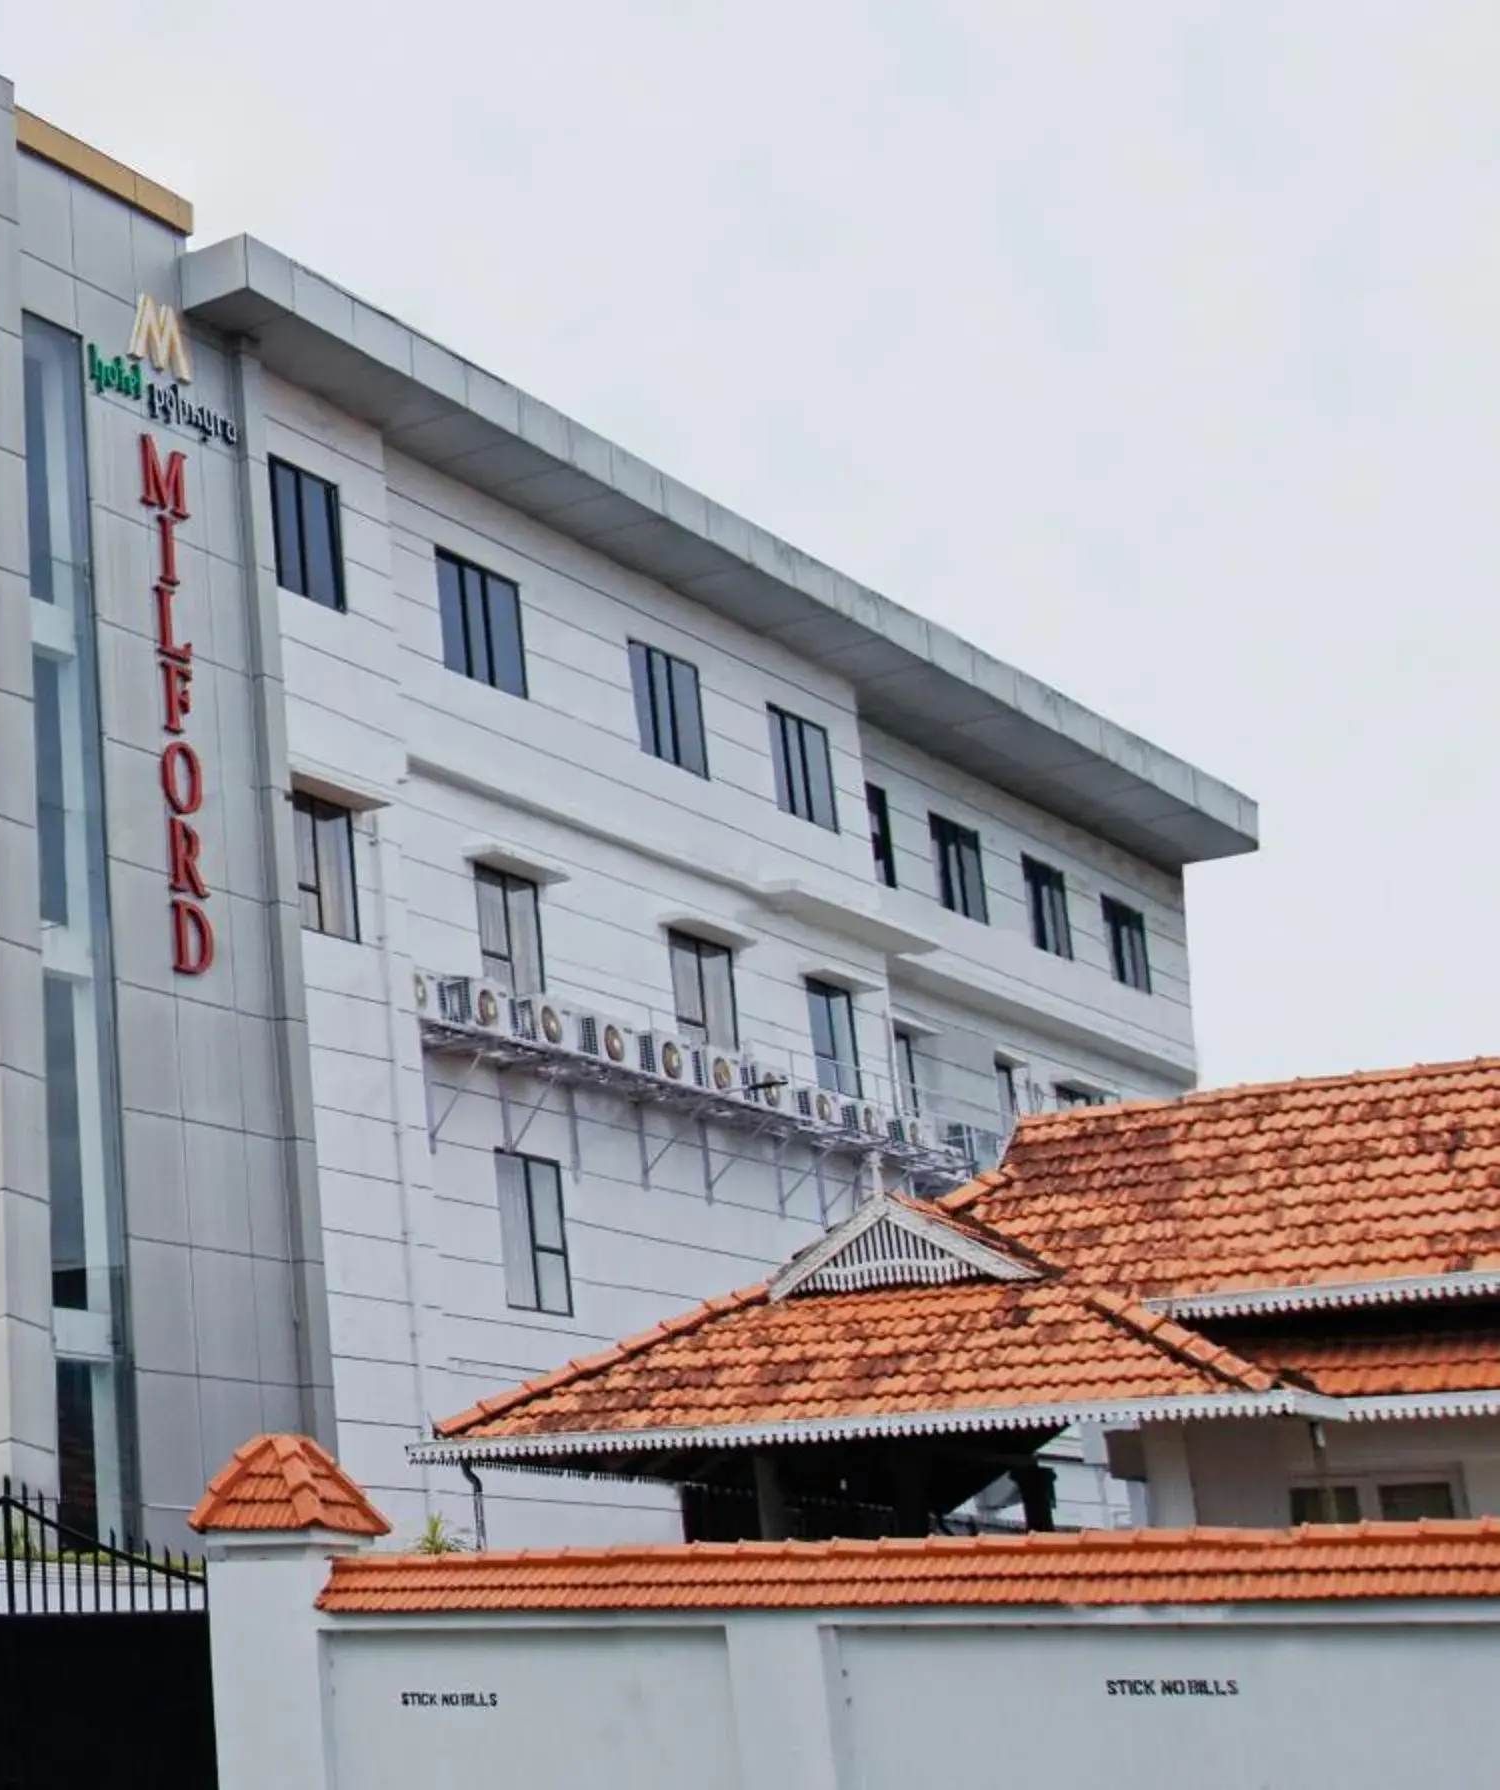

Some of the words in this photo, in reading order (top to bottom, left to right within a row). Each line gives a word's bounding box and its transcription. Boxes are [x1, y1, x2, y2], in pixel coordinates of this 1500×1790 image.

[138, 432, 214, 975] MILFORD
[1106, 1679, 1156, 1696] STICK
[1160, 1679, 1186, 1696] NO
[1187, 1679, 1239, 1696] BILLS
[401, 1692, 437, 1706] STICK
[441, 1692, 459, 1706] NO
